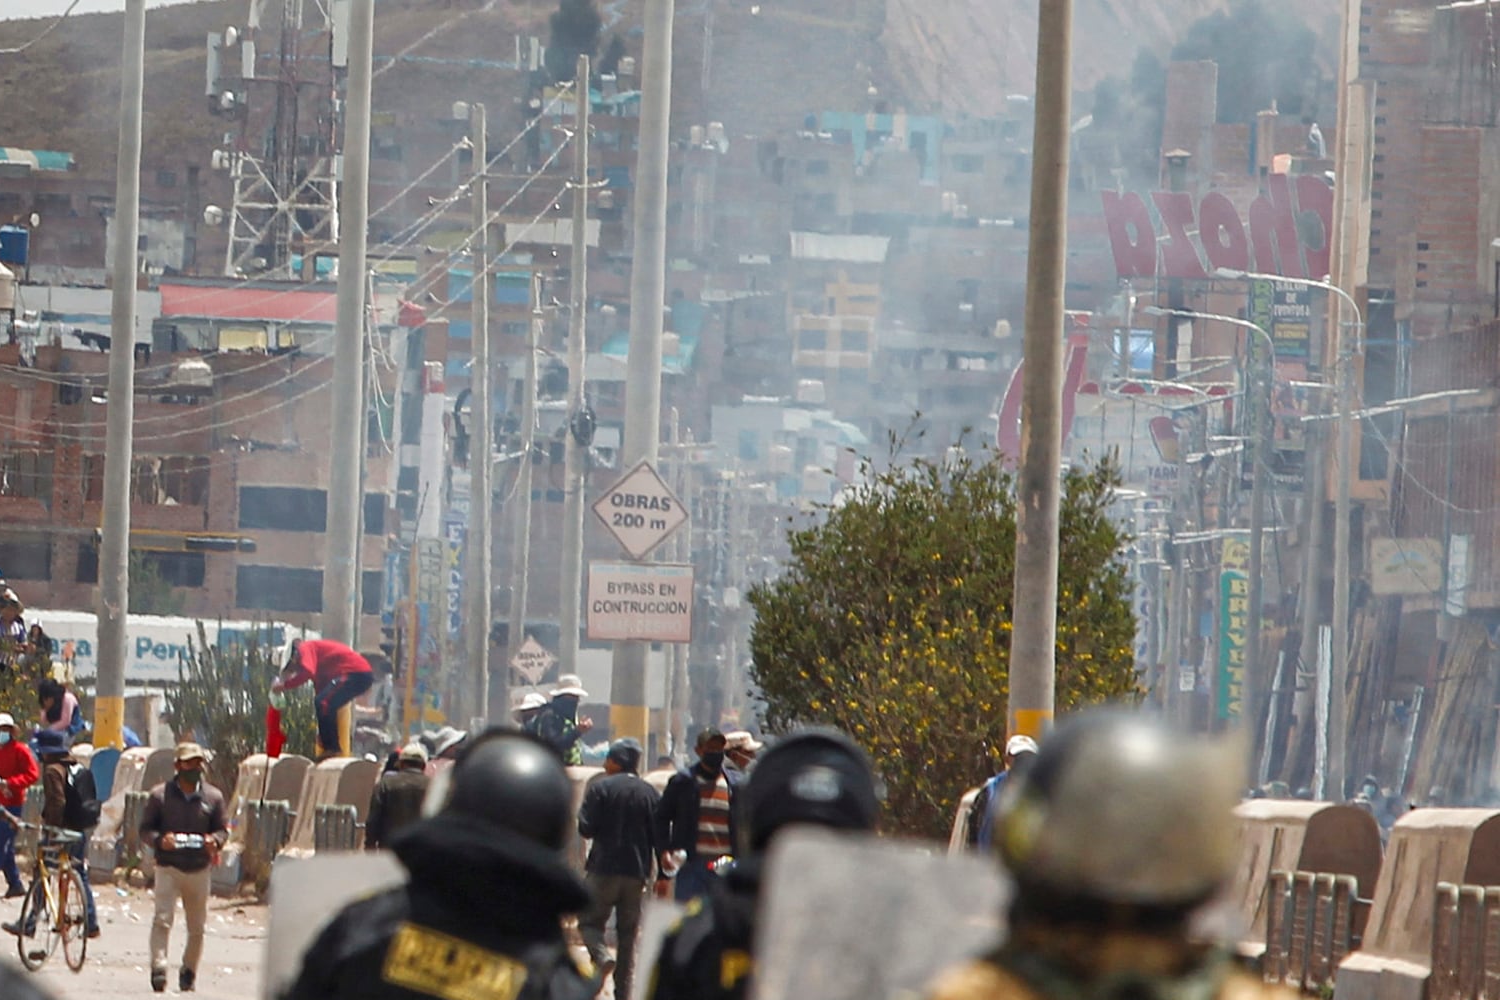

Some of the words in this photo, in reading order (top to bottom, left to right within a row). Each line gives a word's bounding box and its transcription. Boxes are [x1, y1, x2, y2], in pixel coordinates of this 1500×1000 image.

[610, 492, 671, 512] OBRAS
[613, 513, 645, 529] 200
[650, 517, 666, 530] m
[607, 581, 655, 596] BYPASS
[659, 583, 677, 597] EN
